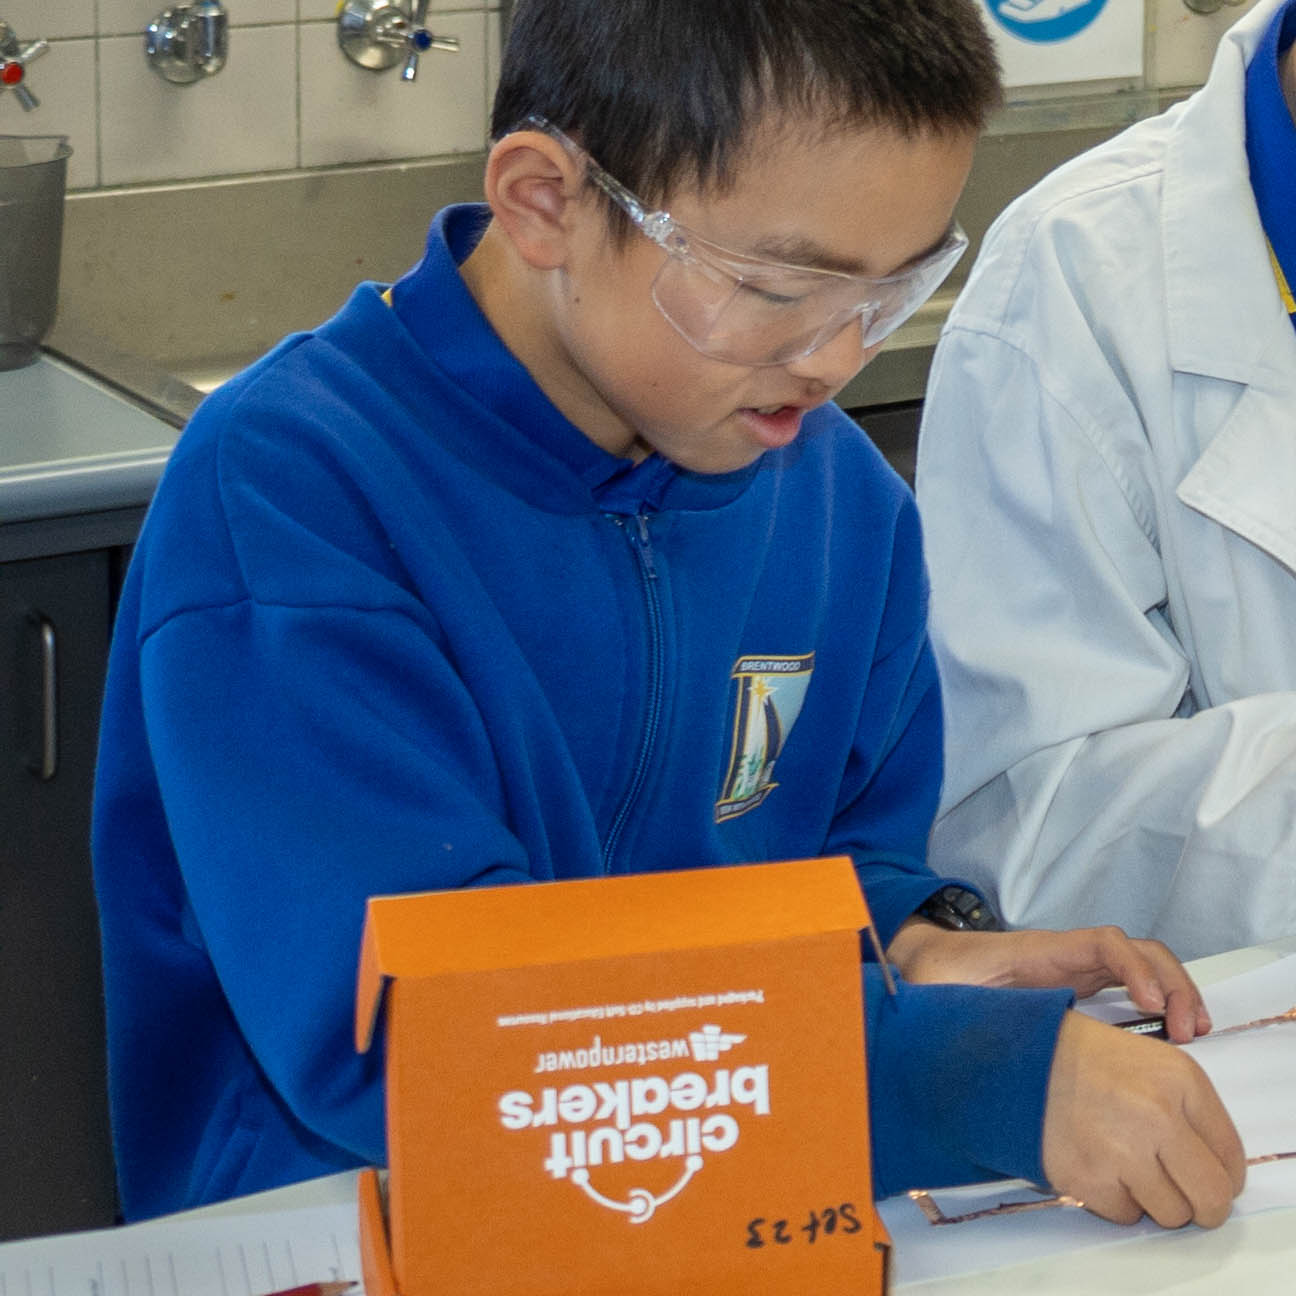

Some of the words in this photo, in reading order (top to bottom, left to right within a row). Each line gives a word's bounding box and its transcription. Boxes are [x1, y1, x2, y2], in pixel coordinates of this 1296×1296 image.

[740, 659, 802, 673] BRENTWOOD
[534, 1035, 691, 1074] westernpower
[498, 1064, 771, 1131] breakers
[544, 1114, 740, 1179] circuit
[745, 1217, 793, 1249] 23
[801, 1202, 862, 1245] Set
